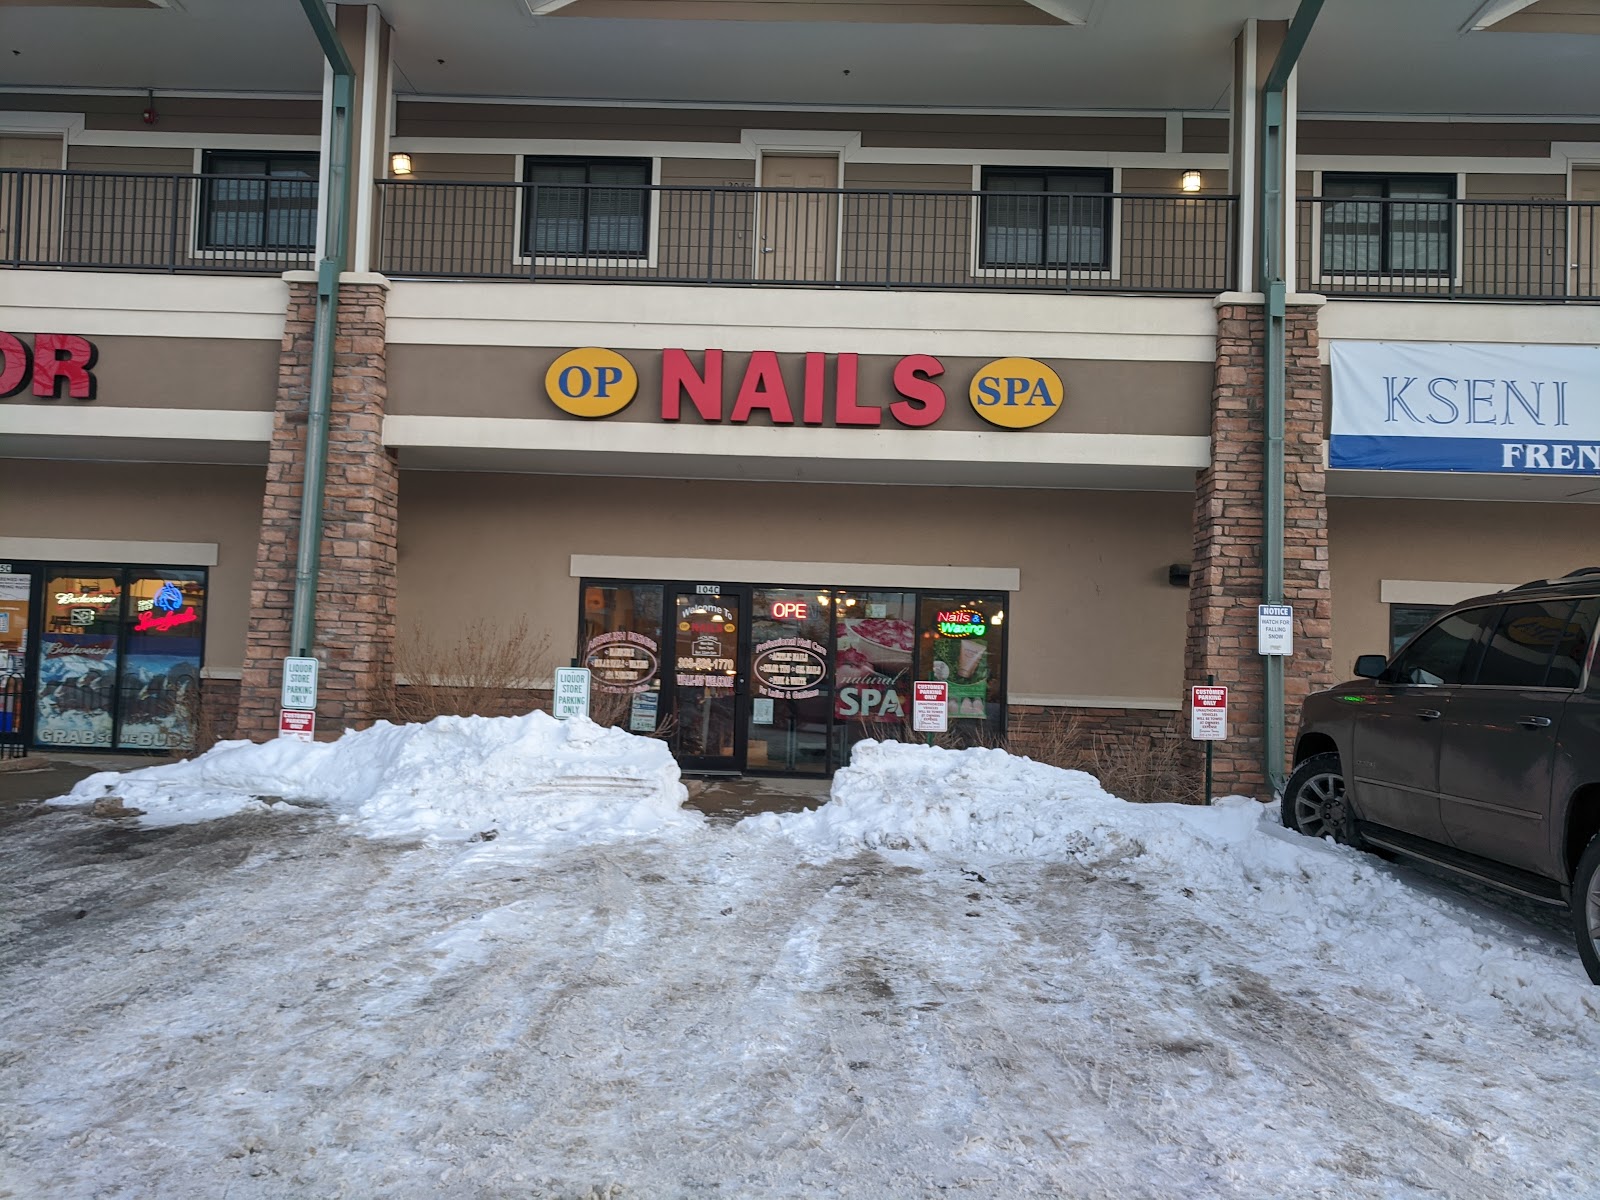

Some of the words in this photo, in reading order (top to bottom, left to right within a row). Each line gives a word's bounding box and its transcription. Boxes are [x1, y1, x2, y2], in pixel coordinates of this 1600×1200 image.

[558, 365, 623, 398] OP
[661, 348, 946, 427] NAILS
[977, 376, 1056, 407] SPA
[1383, 376, 1569, 427] KSENI
[697, 586, 719, 594] 104C
[682, 604, 723, 618] Welcome
[723, 608, 733, 620] To
[937, 611, 970, 622] Nails
[972, 614, 981, 623] &
[1263, 607, 1289, 616] NOTICE
[941, 622, 986, 636] Waxing
[49, 642, 115, 655] Budweiser
[288, 663, 313, 673] LIQUOR
[290, 674, 310, 683] STORE
[560, 674, 586, 683] LIQUOR
[841, 667, 909, 685] natural
[287, 685, 313, 695] PARKING
[562, 684, 582, 694] STORE
[291, 695, 308, 704] ONLY
[558, 695, 586, 705] PARKING
[839, 687, 905, 717] SPA
[563, 705, 580, 714] ONLY
[38, 729, 96, 744] GRAB
[137, 733, 194, 748] BUDS
